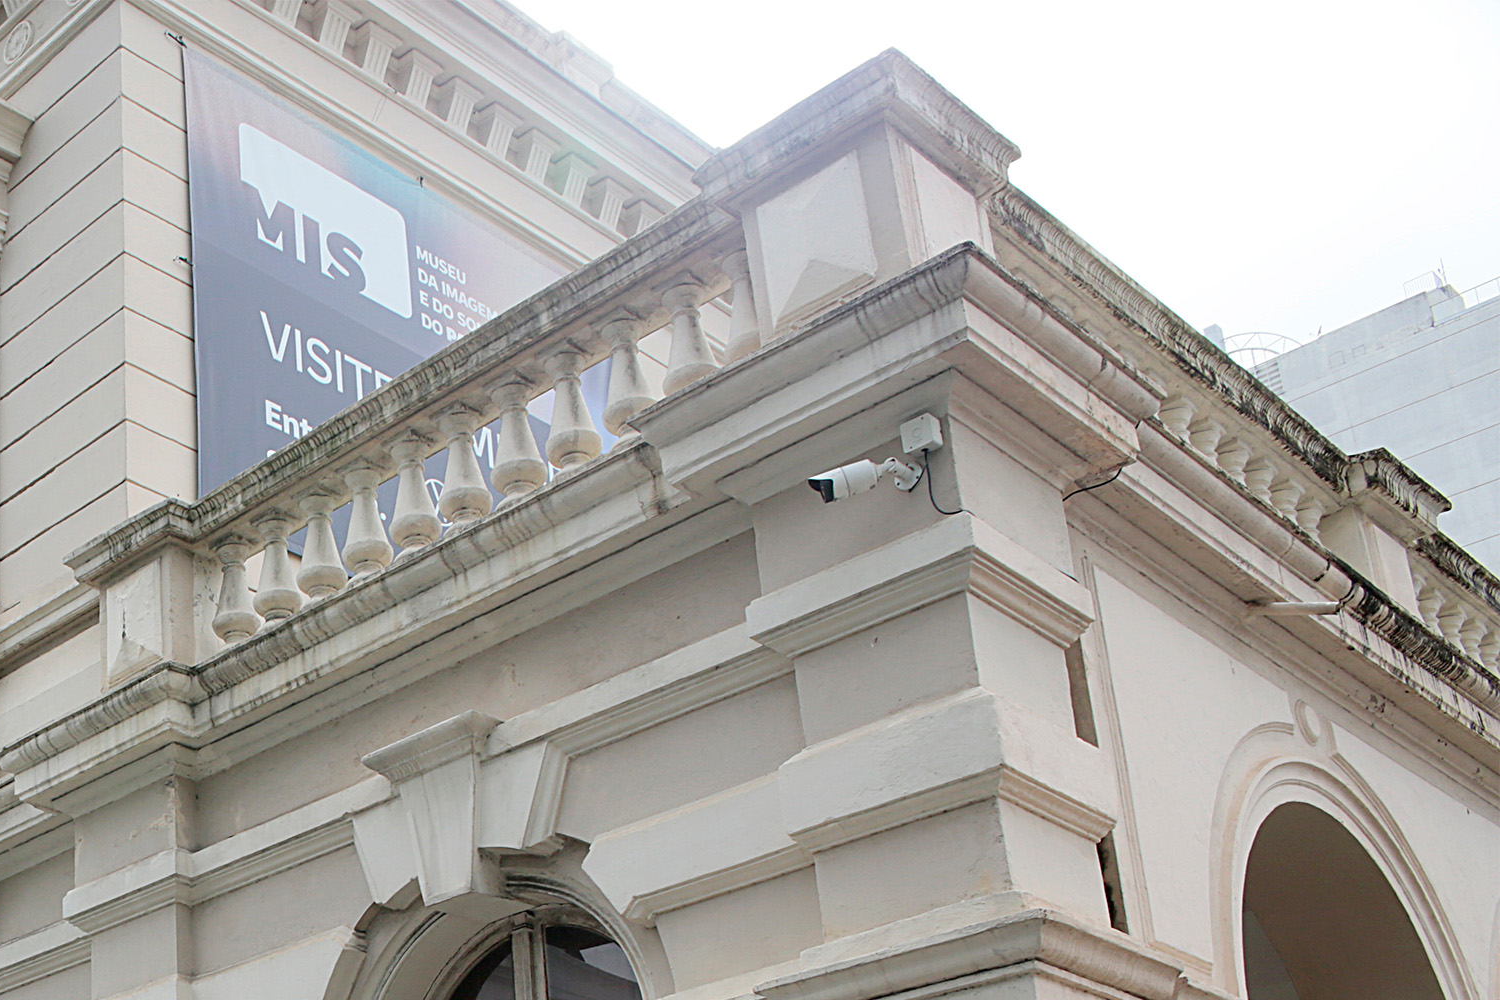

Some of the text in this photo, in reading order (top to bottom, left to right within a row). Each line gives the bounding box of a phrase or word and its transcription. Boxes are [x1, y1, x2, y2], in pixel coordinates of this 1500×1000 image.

[241, 180, 366, 296] MIS
[416, 245, 466, 285] MUSEU
[418, 267, 439, 292] DA
[419, 290, 481, 332] E DO SO
[421, 312, 444, 336] DO
